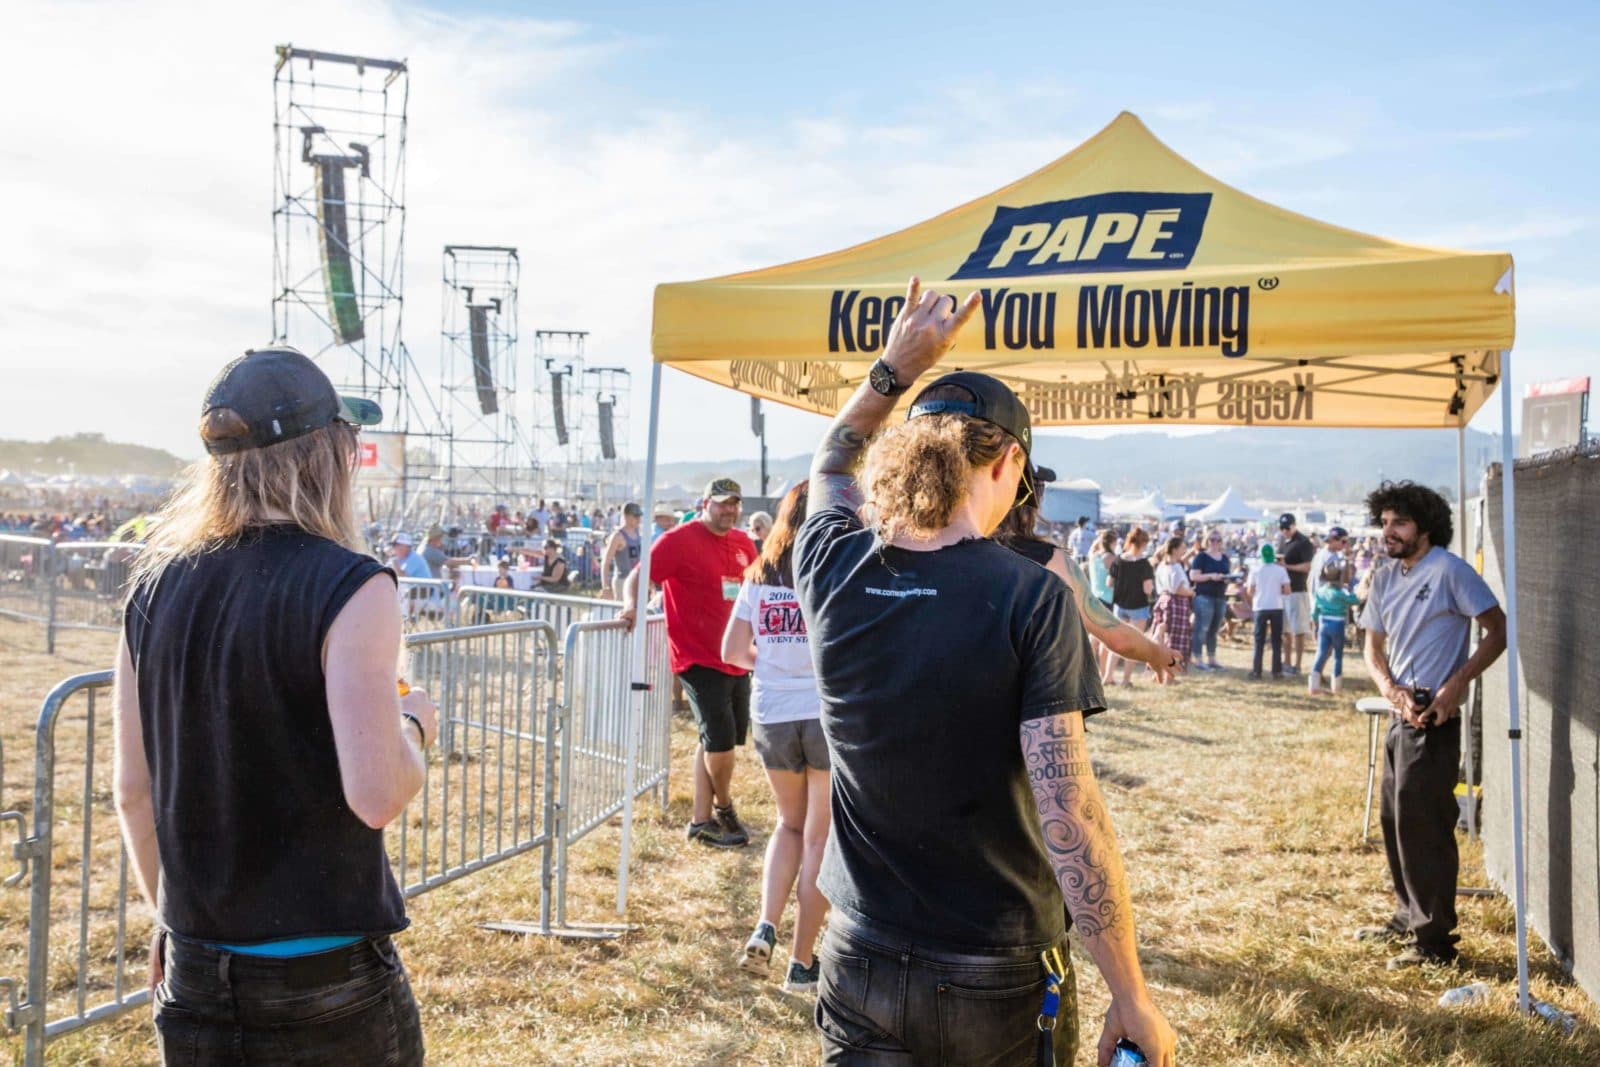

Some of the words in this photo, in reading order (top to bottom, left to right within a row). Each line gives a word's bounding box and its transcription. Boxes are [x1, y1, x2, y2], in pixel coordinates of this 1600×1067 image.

[828, 290, 957, 353] Kee
[980, 288, 1057, 350] You
[1077, 281, 1250, 358] Moving
[768, 591, 795, 601] 2016
